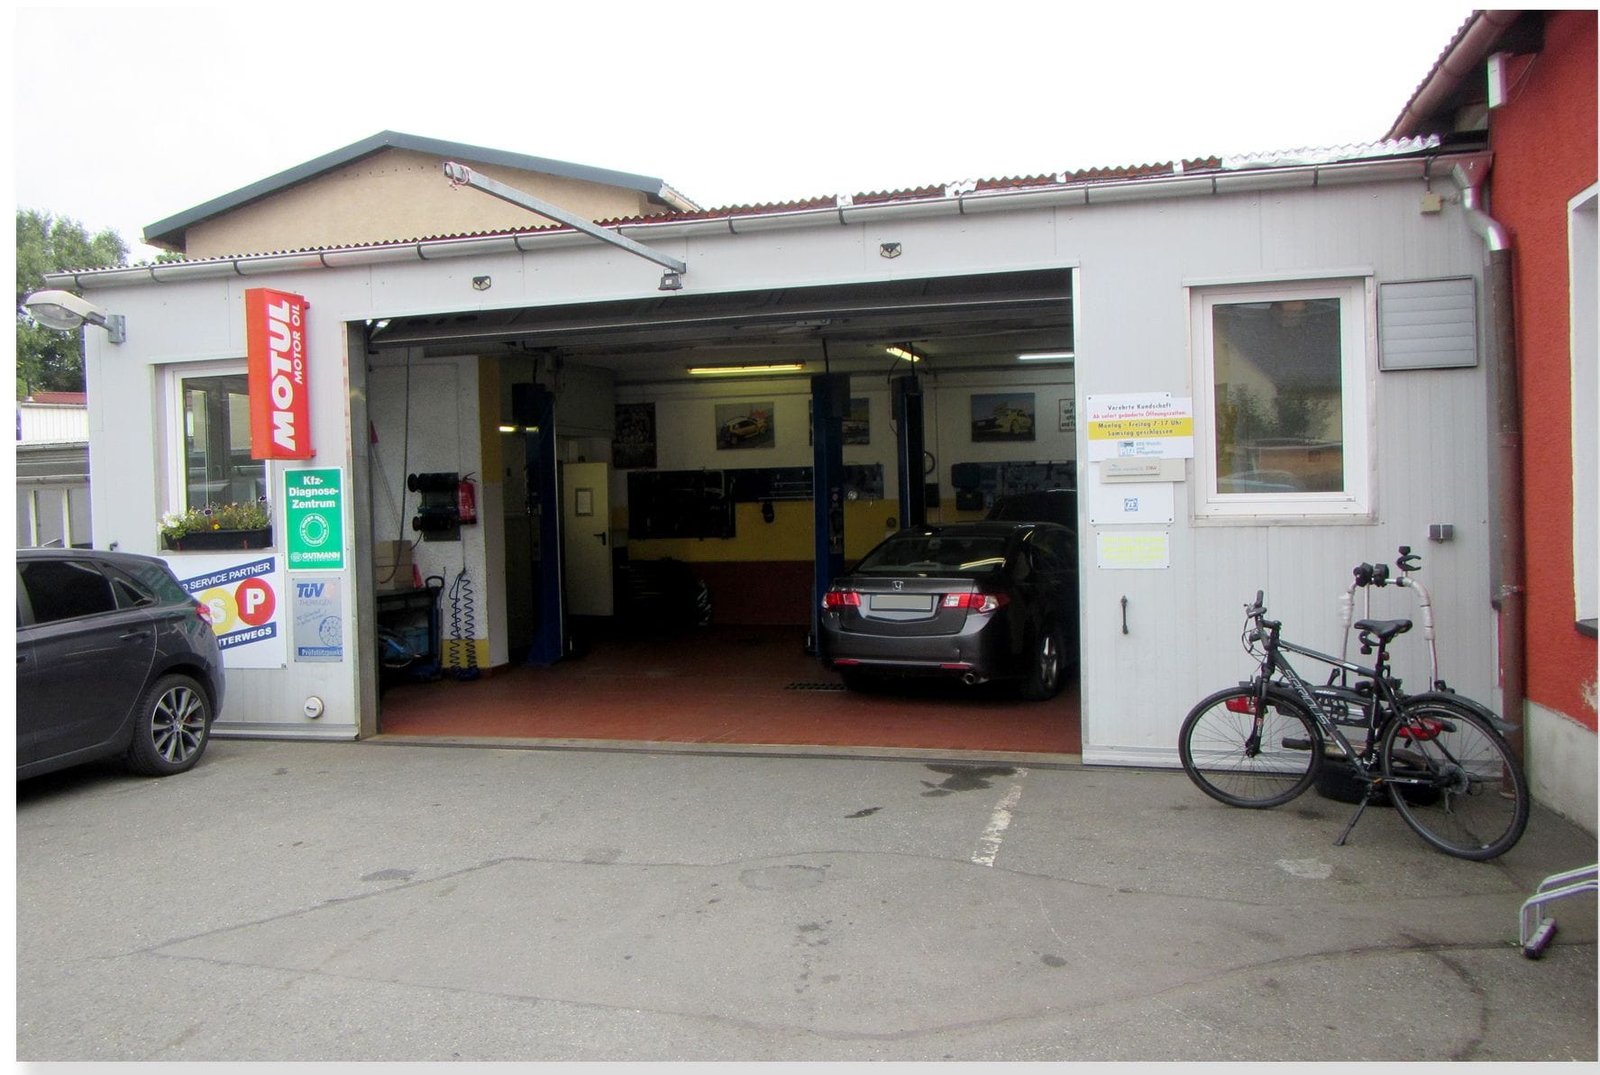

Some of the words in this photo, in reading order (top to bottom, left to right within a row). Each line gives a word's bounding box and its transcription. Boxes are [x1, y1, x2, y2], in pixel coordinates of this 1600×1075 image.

[291, 304, 300, 327] OIL
[292, 331, 303, 384] MOTOR
[268, 300, 296, 451] MOTUL
[303, 476, 323, 485] Kfz-
[288, 487, 339, 498] Diagnose-
[292, 499, 336, 509] Zentrum
[302, 552, 340, 560] GUTMANN
[190, 573, 227, 589] SERVICE
[229, 562, 271, 580] PARTNER
[296, 583, 325, 598] TÜV
[208, 599, 226, 624] S
[246, 588, 266, 614] P
[219, 627, 272, 647] TERWEGS
